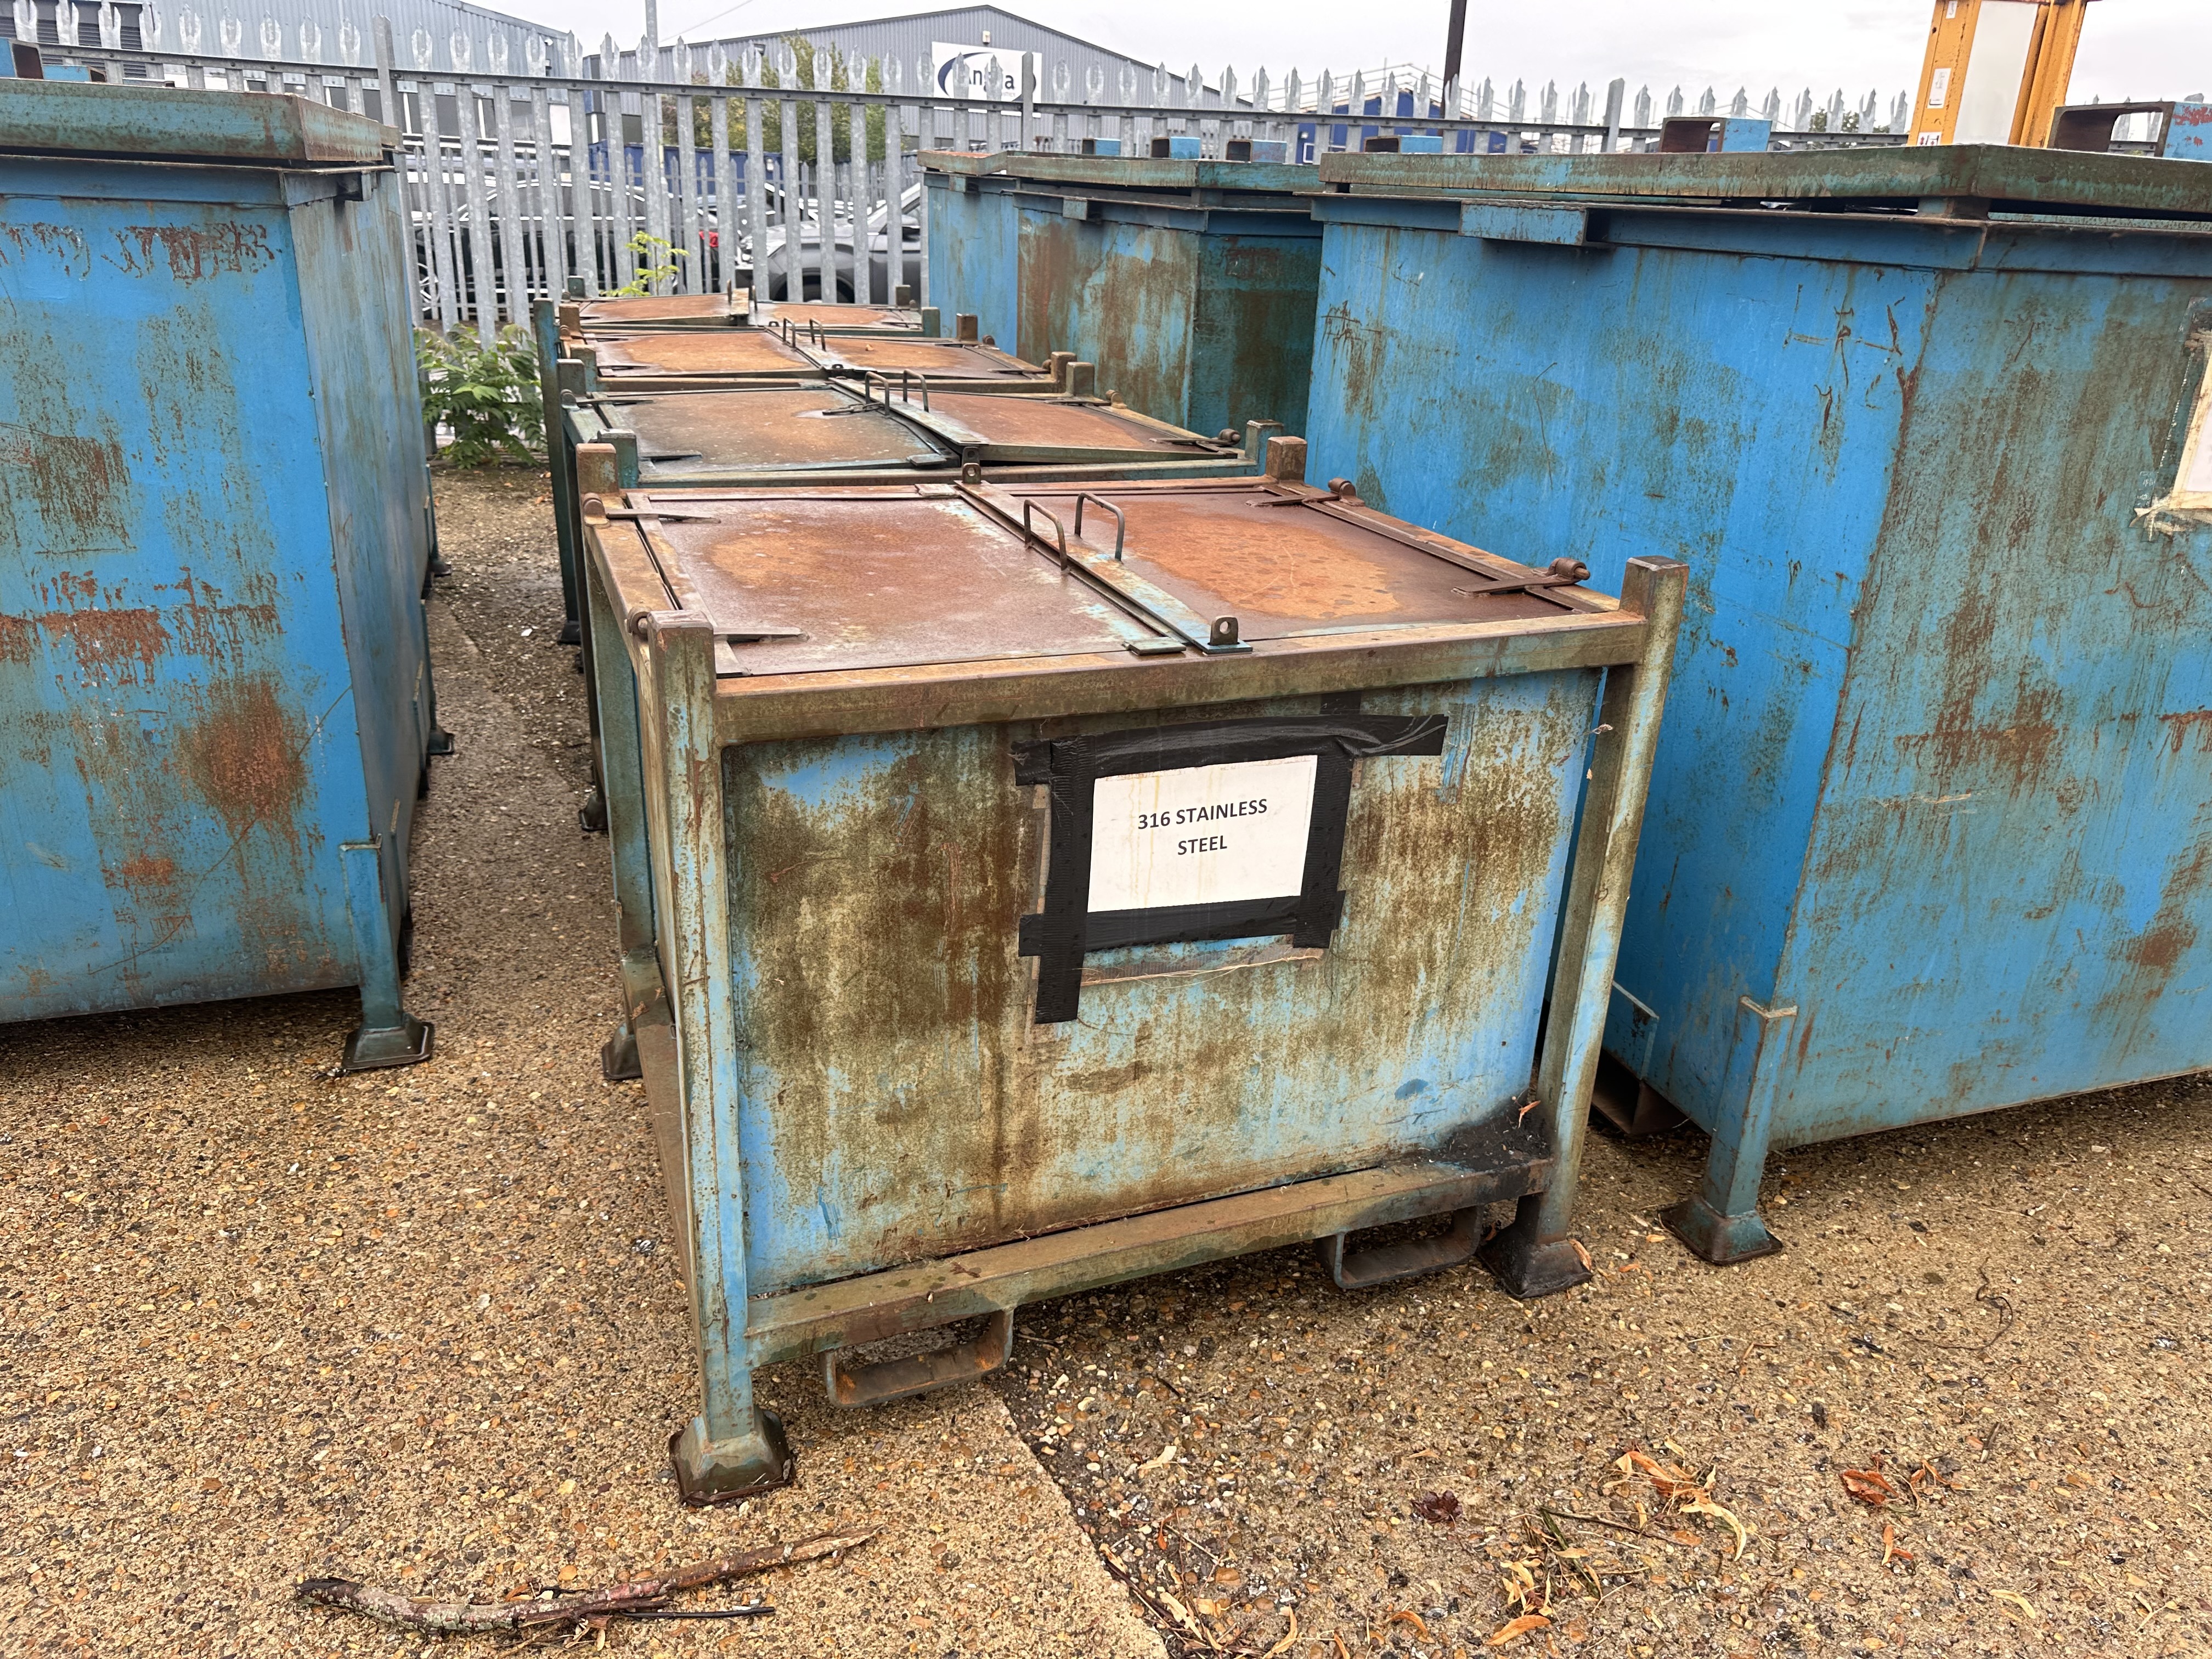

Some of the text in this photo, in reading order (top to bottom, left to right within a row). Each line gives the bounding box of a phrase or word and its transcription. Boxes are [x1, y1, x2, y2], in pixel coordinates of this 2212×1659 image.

[1138, 798, 1268, 830] 316 STAINLESS
[1177, 835, 1228, 855] STEEL
